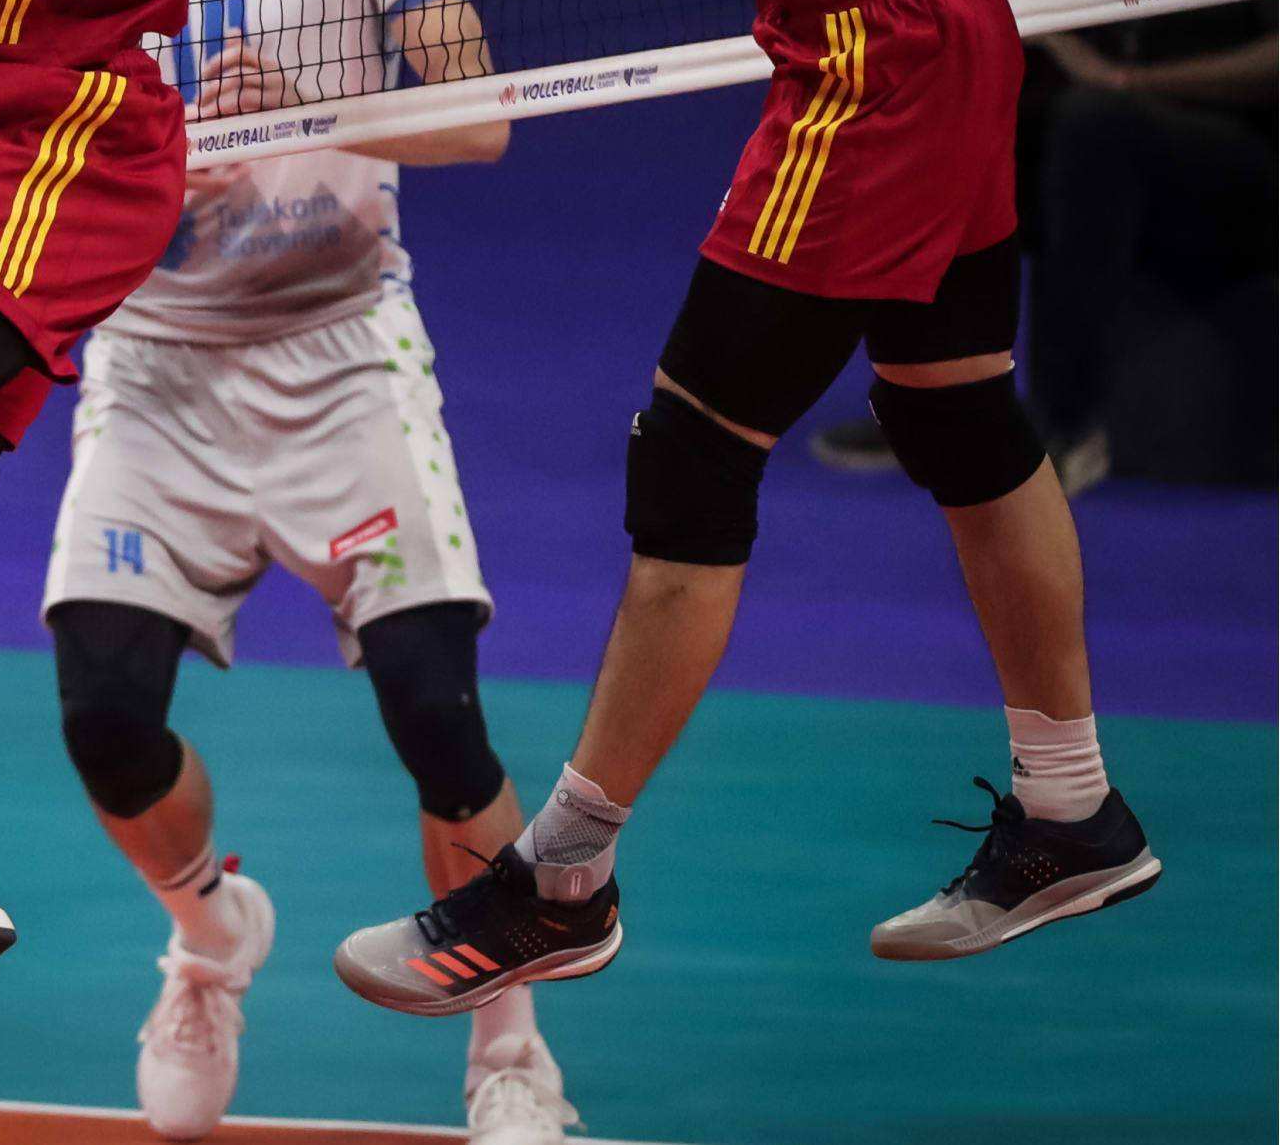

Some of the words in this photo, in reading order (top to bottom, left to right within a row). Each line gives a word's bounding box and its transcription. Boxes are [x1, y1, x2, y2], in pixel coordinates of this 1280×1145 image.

[522, 75, 595, 101] VOLLEYBALL
[198, 125, 271, 154] VOLLEYBALL
[103, 528, 144, 575] 14
